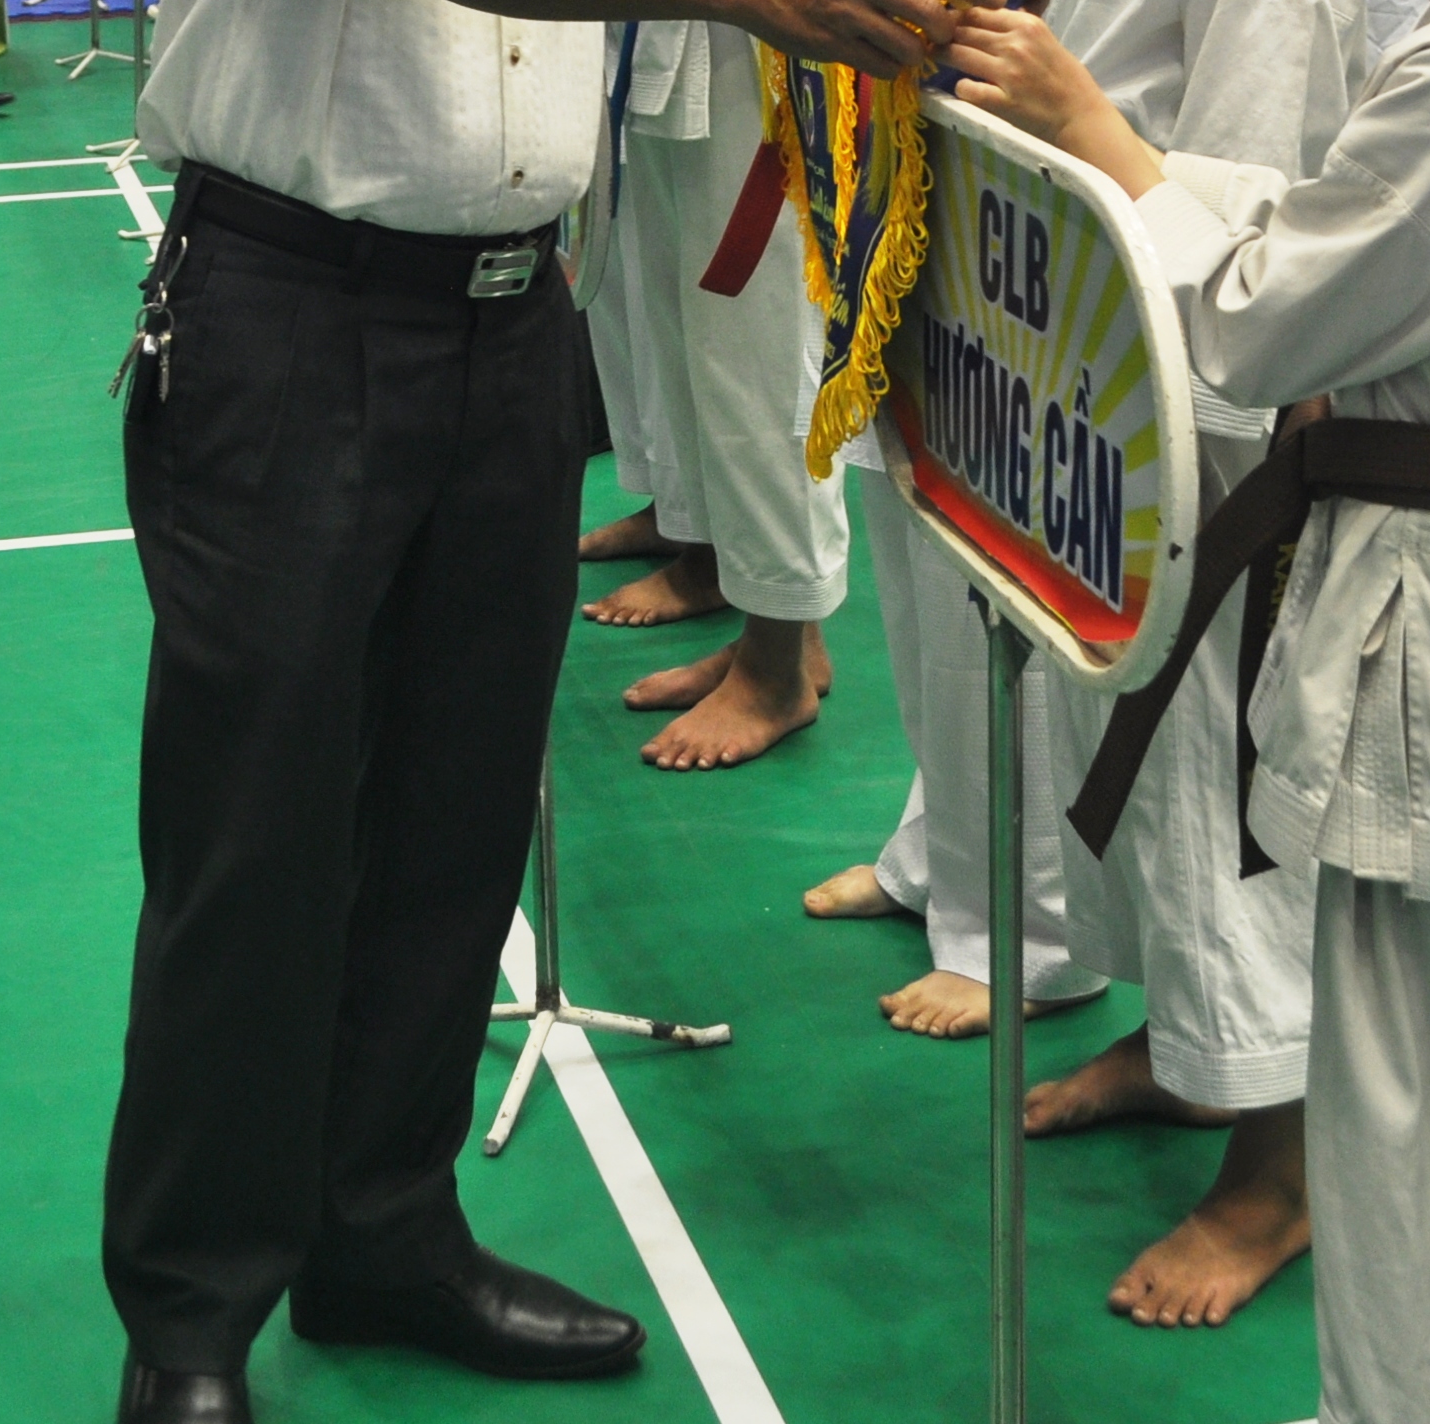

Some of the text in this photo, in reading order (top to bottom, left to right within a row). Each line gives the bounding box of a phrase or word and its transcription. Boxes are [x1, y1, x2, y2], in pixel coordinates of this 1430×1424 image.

[980, 188, 1049, 333] CLB
[924, 311, 1122, 607] HƯƠNG CẦN
